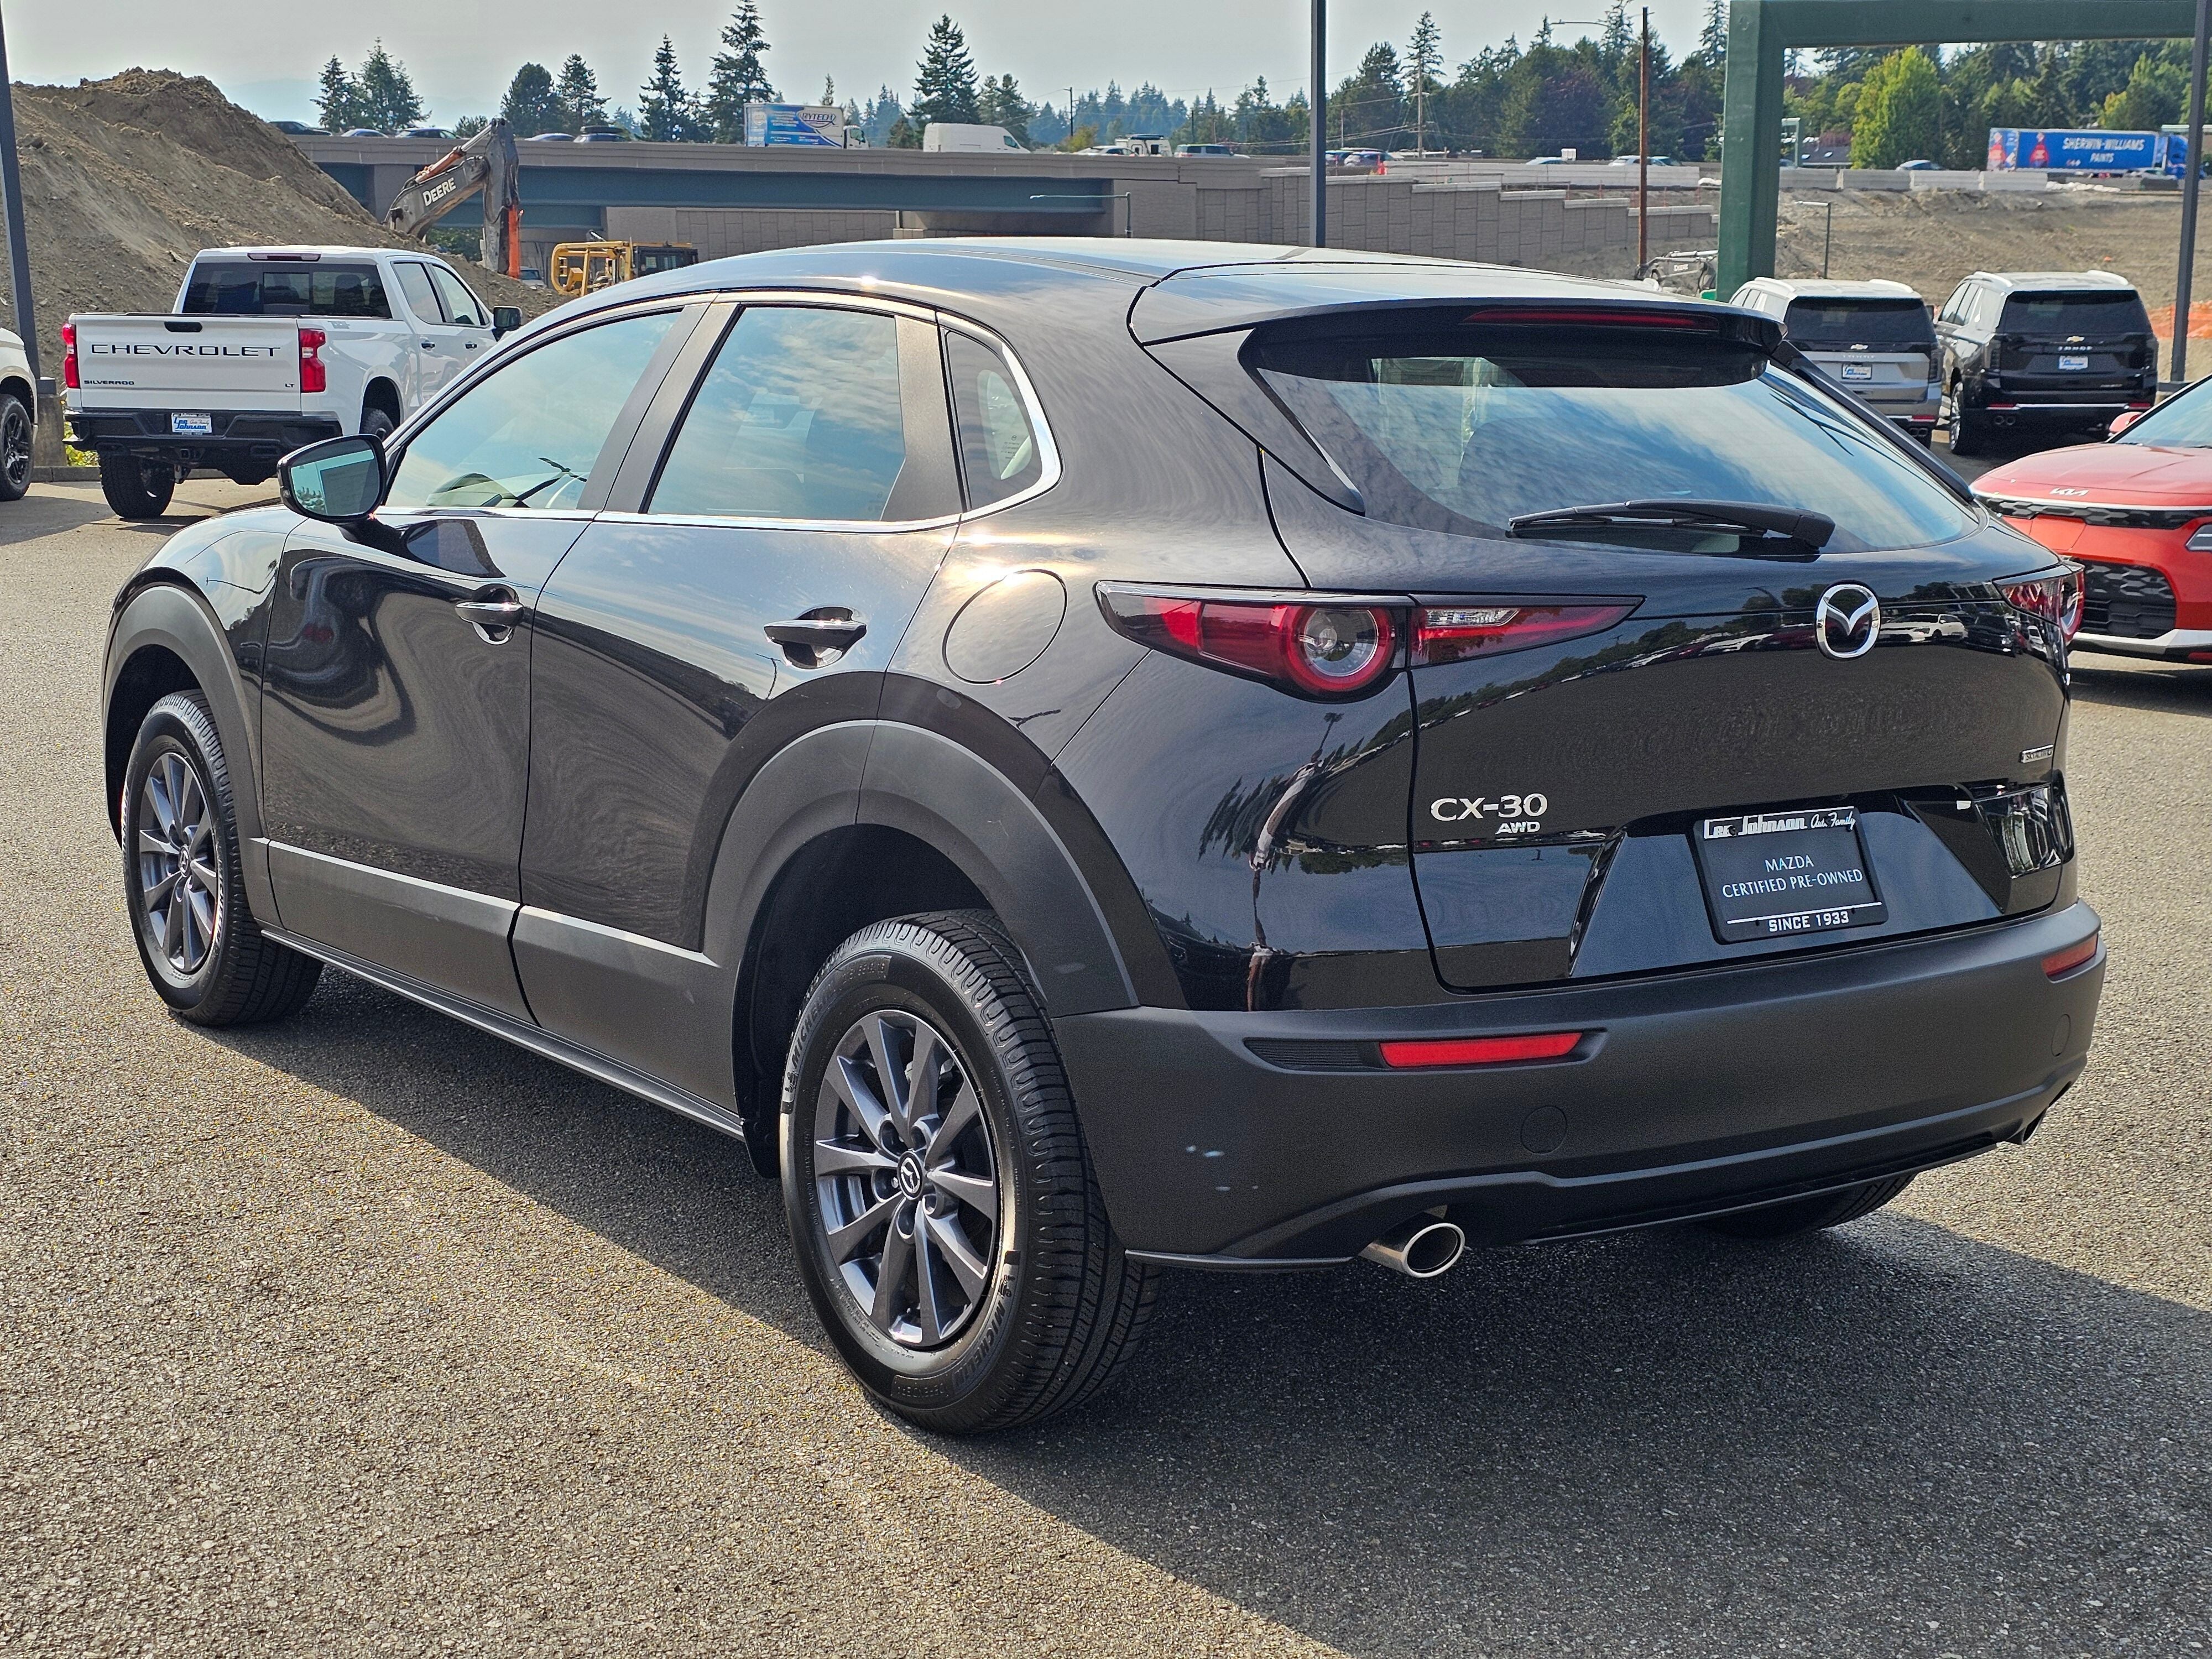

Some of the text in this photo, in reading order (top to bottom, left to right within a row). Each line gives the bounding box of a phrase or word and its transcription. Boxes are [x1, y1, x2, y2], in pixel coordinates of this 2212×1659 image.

[2062, 137, 2145, 151] SHERWIN-WILLIAMS
[2090, 153, 2115, 163] PAINTS
[422, 177, 456, 206] DEERE
[91, 344, 280, 357] CHEVROLET
[175, 421, 207, 430] Johnson
[2049, 488, 2089, 496] KIA
[1431, 793, 1548, 821] CX-30
[1495, 821, 1541, 834] AWD
[1738, 814, 1808, 836] Johnson
[1811, 813, 1829, 828] Aut
[1828, 811, 1856, 830] Family
[1765, 855, 1814, 872] MAZDA
[1722, 869, 1864, 898] CERTIFIED PRE-OWNED
[1769, 911, 1849, 932] SINCE 1933
[953, 1300, 1006, 1387] MICHELIN
